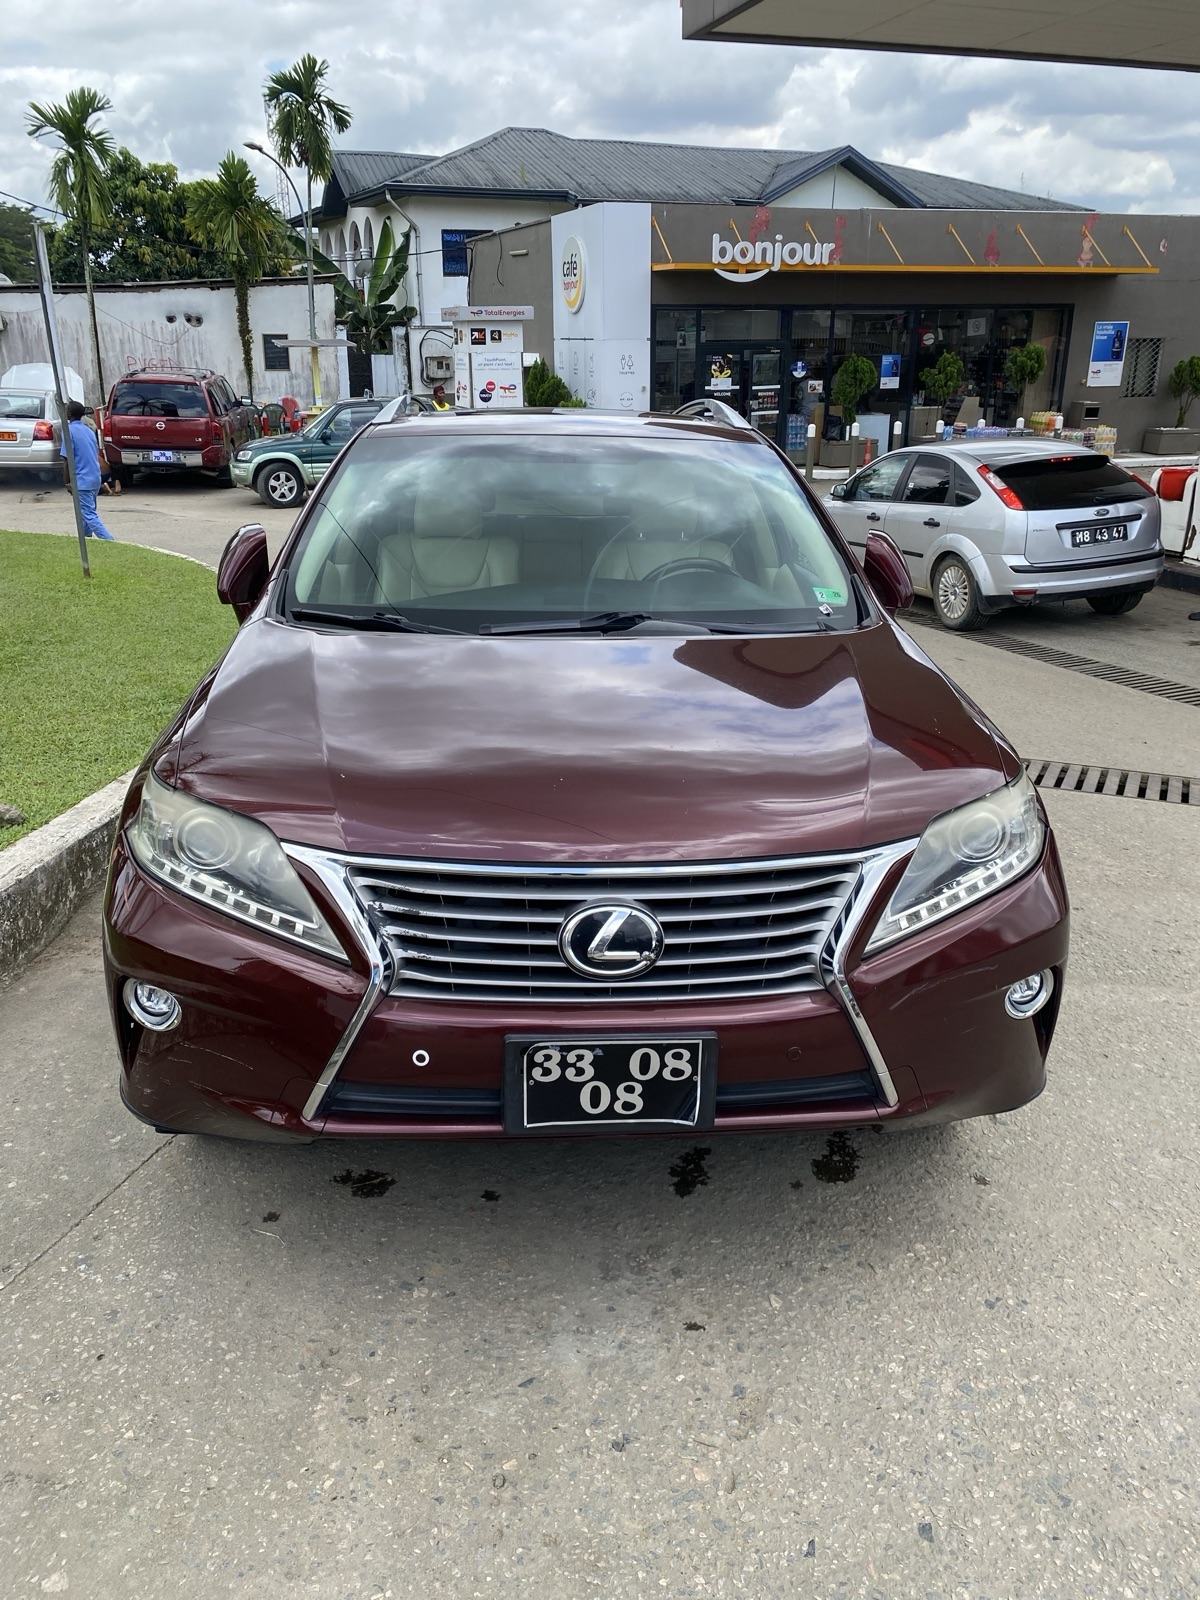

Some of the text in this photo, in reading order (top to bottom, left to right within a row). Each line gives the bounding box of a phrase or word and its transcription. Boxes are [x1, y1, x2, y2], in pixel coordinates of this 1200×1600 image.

[712, 233, 835, 271] bonjour
[562, 253, 578, 277] café
[563, 278, 578, 293] bonjour
[484, 309, 525, 317] TotalEnergies
[1096, 529, 1108, 540] 43
[1113, 527, 1124, 538] 47
[531, 1048, 693, 1082] 33 08
[580, 1081, 644, 1114] 08
